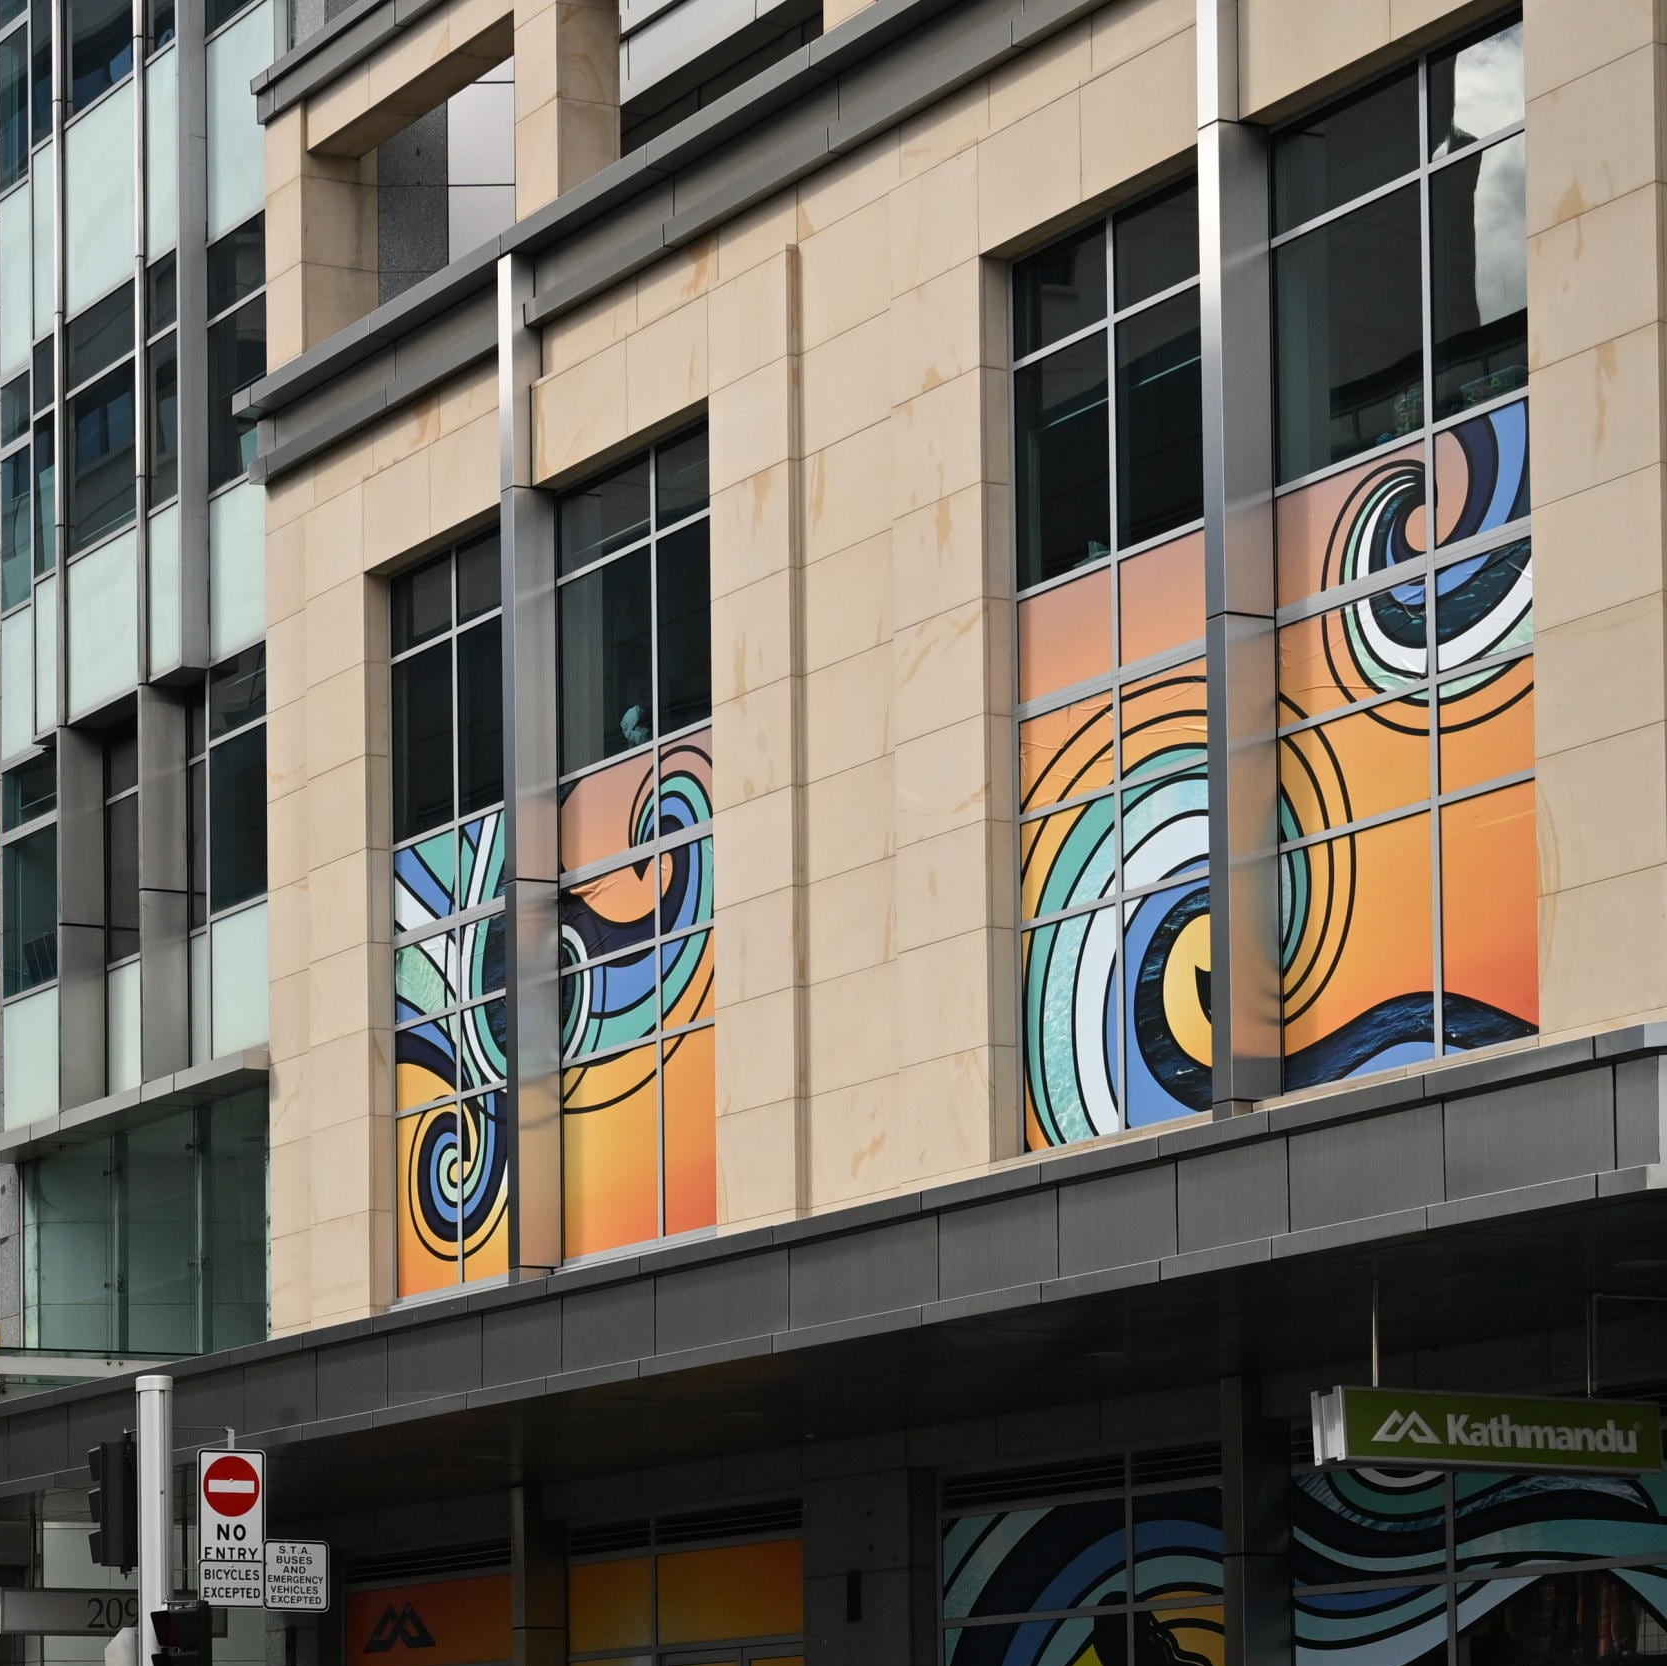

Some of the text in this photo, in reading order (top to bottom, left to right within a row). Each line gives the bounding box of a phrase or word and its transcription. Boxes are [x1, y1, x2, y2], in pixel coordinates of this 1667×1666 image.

[1446, 1412, 1638, 1454] Kathmandu
[216, 1524, 247, 1541] NO
[204, 1547, 258, 1560] ENTRY
[278, 1545, 312, 1555] S.T.A.
[275, 1556, 313, 1565] BUSES
[204, 1568, 260, 1581] BICYCLES
[282, 1566, 306, 1574] AND
[267, 1575, 324, 1585] EMERGENCY
[203, 1587, 261, 1599] EXCEPTED
[270, 1585, 319, 1595] VEHICLES
[271, 1595, 322, 1605] EXCEPTED
[87, 1597, 138, 1629] 209
